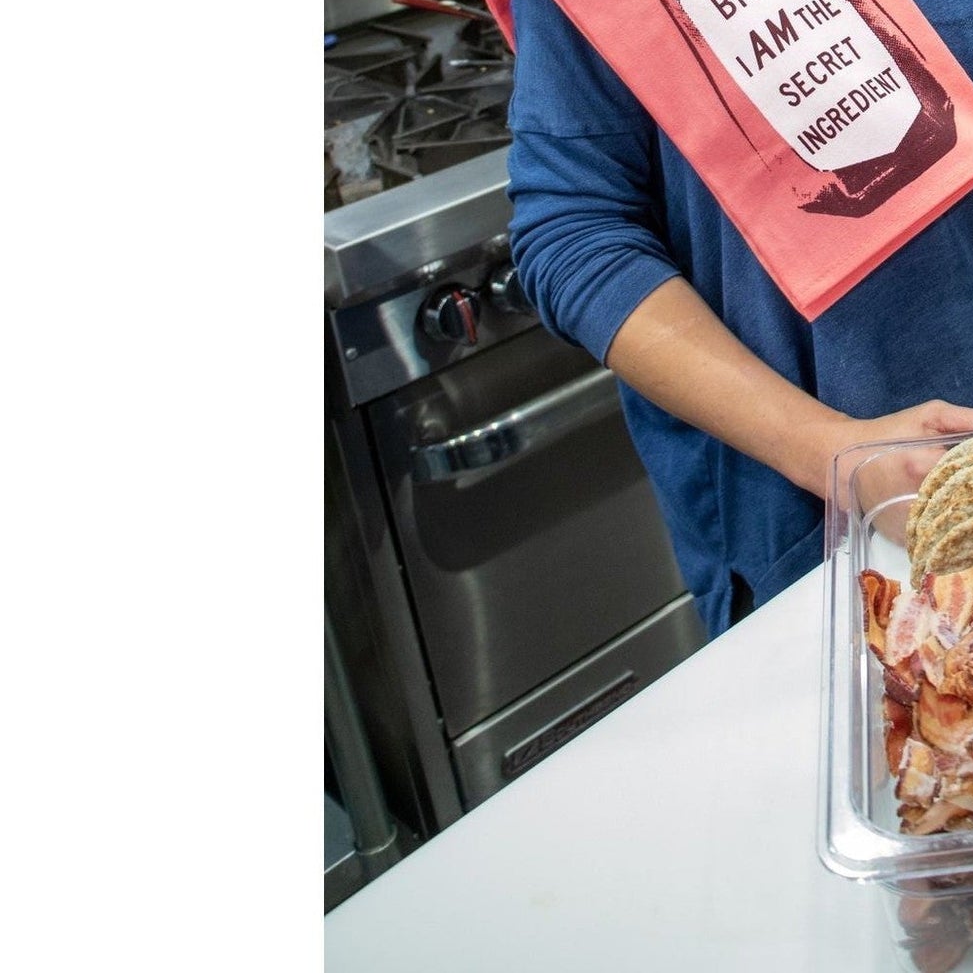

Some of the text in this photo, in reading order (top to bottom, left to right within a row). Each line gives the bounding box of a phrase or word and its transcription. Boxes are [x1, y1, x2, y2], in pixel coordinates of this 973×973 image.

[735, 55, 754, 78] I
[749, 7, 800, 71] AM
[778, 36, 862, 108] SECRET
[797, 67, 901, 155] INGREDIENT
